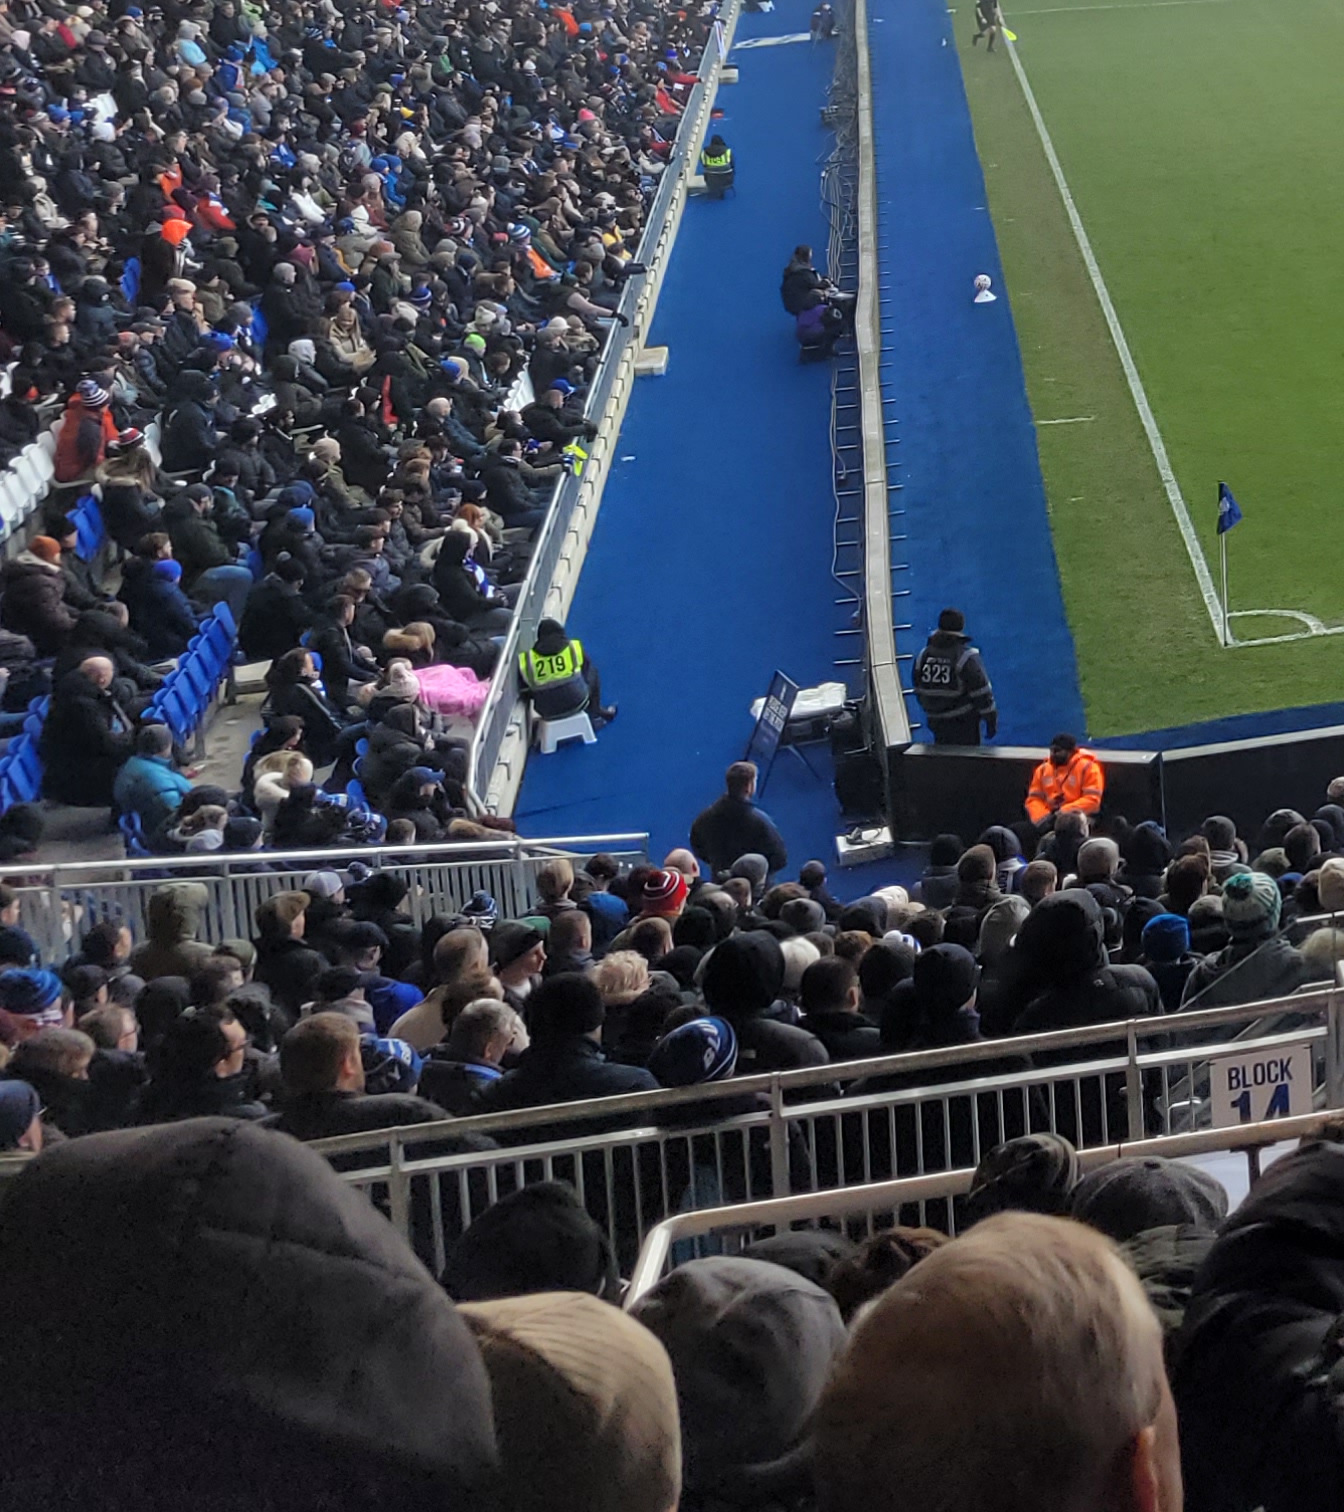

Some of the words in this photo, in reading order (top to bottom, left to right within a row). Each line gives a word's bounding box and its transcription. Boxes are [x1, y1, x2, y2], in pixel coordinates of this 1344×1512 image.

[535, 655, 566, 678] 219
[921, 663, 951, 684] 323
[1227, 1056, 1294, 1091] BLOCK
